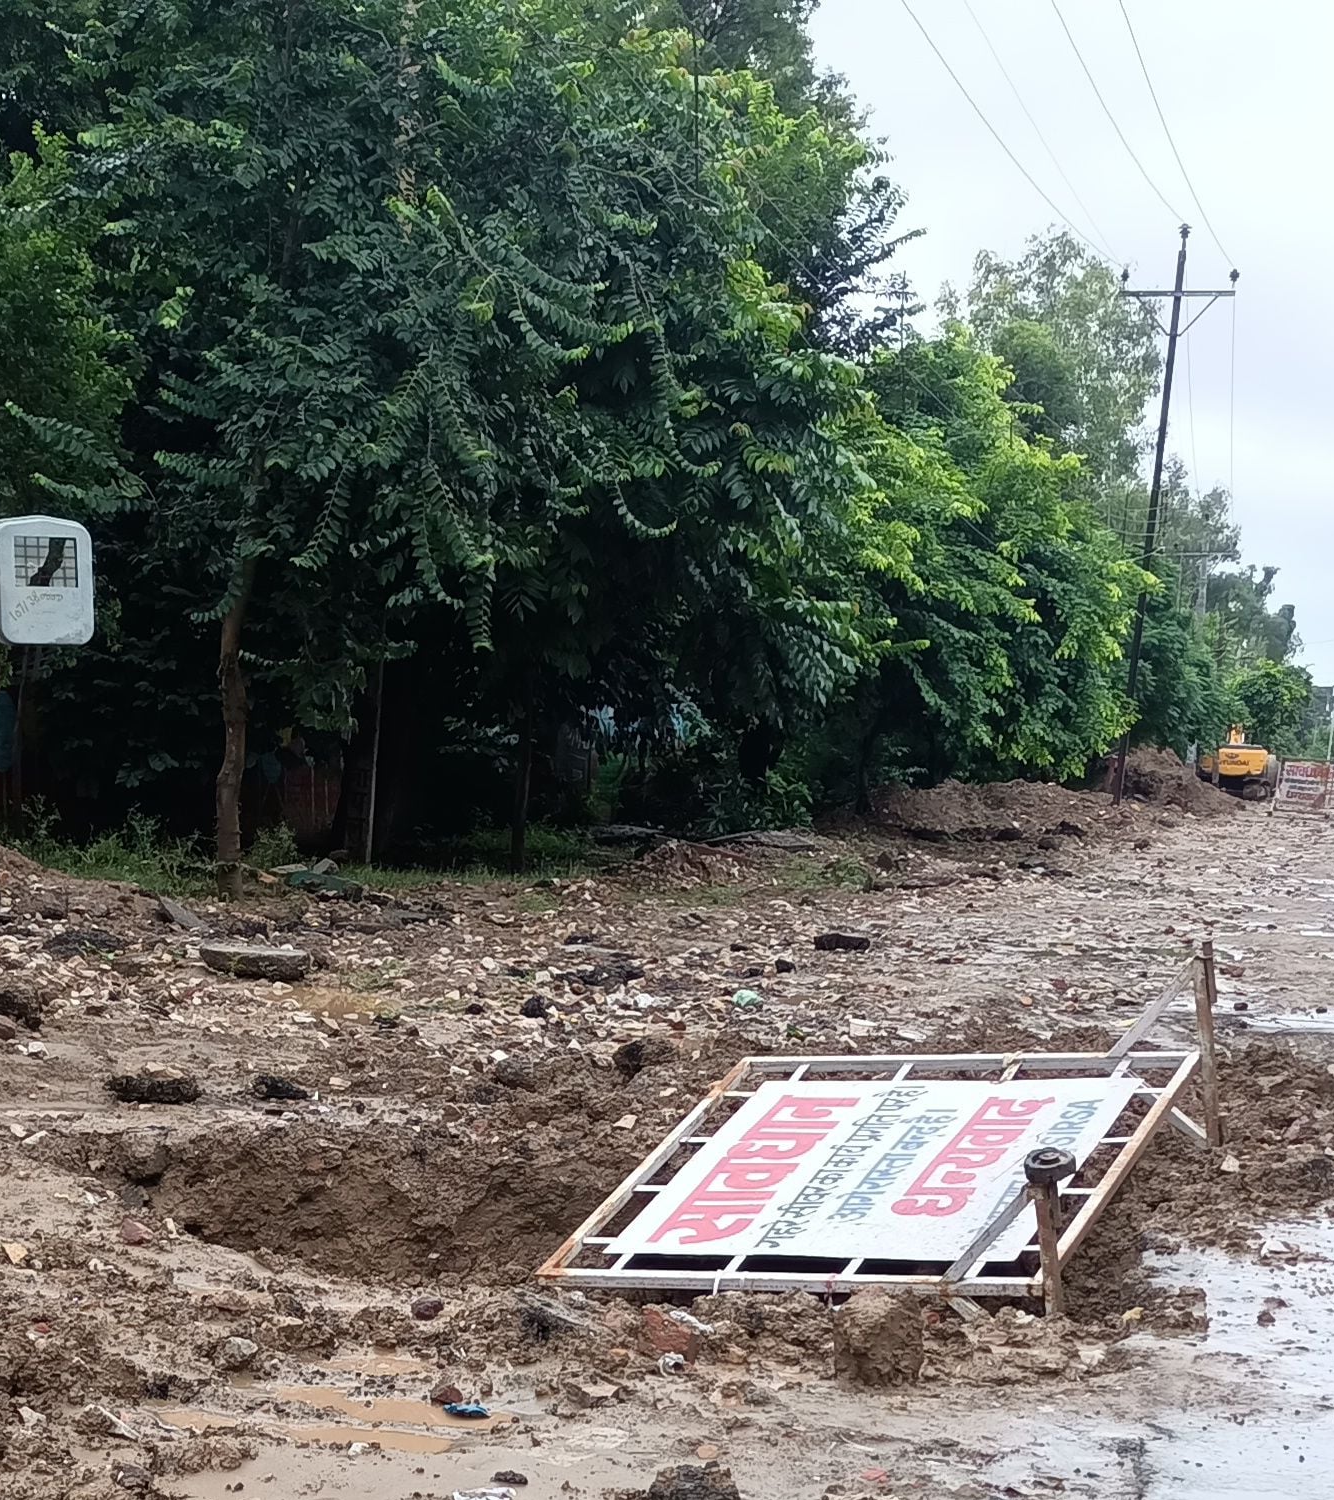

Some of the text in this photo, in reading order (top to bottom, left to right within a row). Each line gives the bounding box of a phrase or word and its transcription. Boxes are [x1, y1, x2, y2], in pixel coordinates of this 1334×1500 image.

[873, 1097, 918, 1112] पर
[844, 1113, 901, 1143] प्रगति
[890, 1124, 947, 1150] बन्द
[1040, 1098, 1105, 1147] SIRSA
[646, 1095, 860, 1244] सावधान
[822, 1144, 872, 1167] कार्य
[855, 1152, 916, 1189] रास्ता
[891, 1096, 1055, 1217] धन्यवाद
[807, 1168, 852, 1184] का
[776, 1183, 838, 1218] सीवर
[826, 1190, 885, 1222] आगे
[753, 1219, 809, 1248] गहरे
